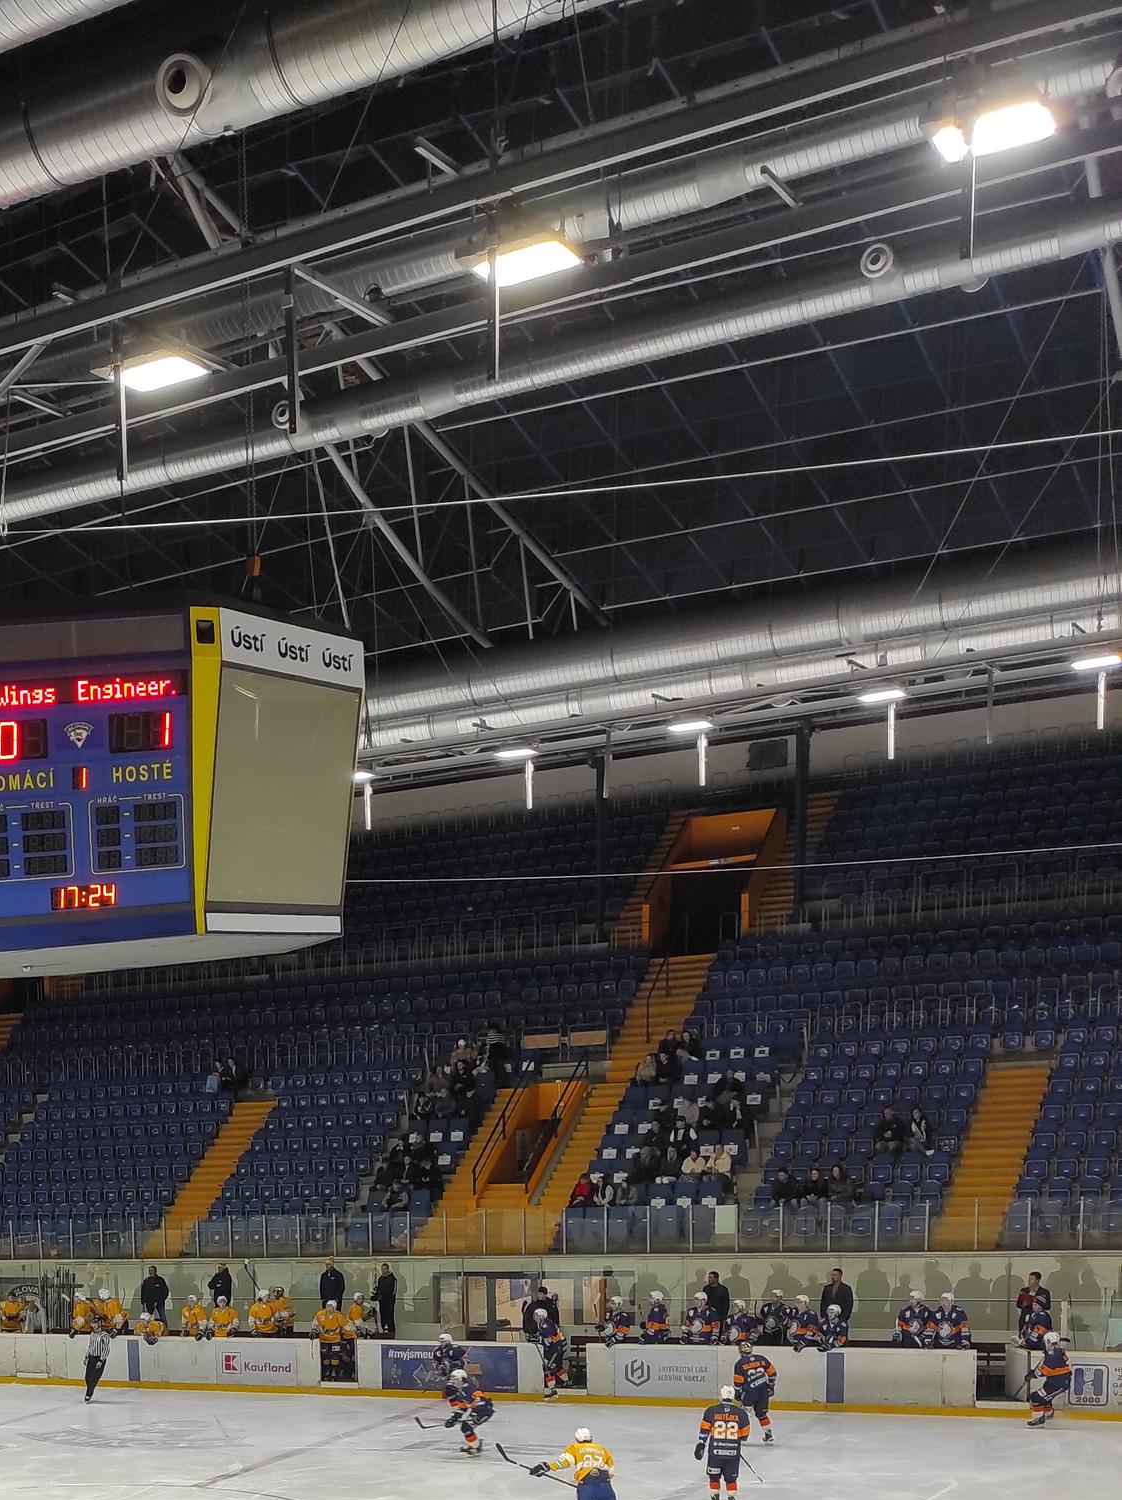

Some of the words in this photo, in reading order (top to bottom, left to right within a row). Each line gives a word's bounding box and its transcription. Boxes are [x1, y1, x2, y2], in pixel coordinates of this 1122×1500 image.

[231, 626, 266, 652] Ústí
[278, 637, 311, 662] Ústí
[322, 647, 354, 672] Ústí
[163, 712, 171, 746] 1
[112, 760, 172, 783] HOSTÉ
[30, 801, 54, 809] TREST
[143, 791, 166, 800] TREST
[60, 884, 116, 909] 17:24
[244, 1361, 292, 1373] Kaufland
[1075, 1396, 1101, 1404] 2000
[713, 1420, 739, 1440] 22
